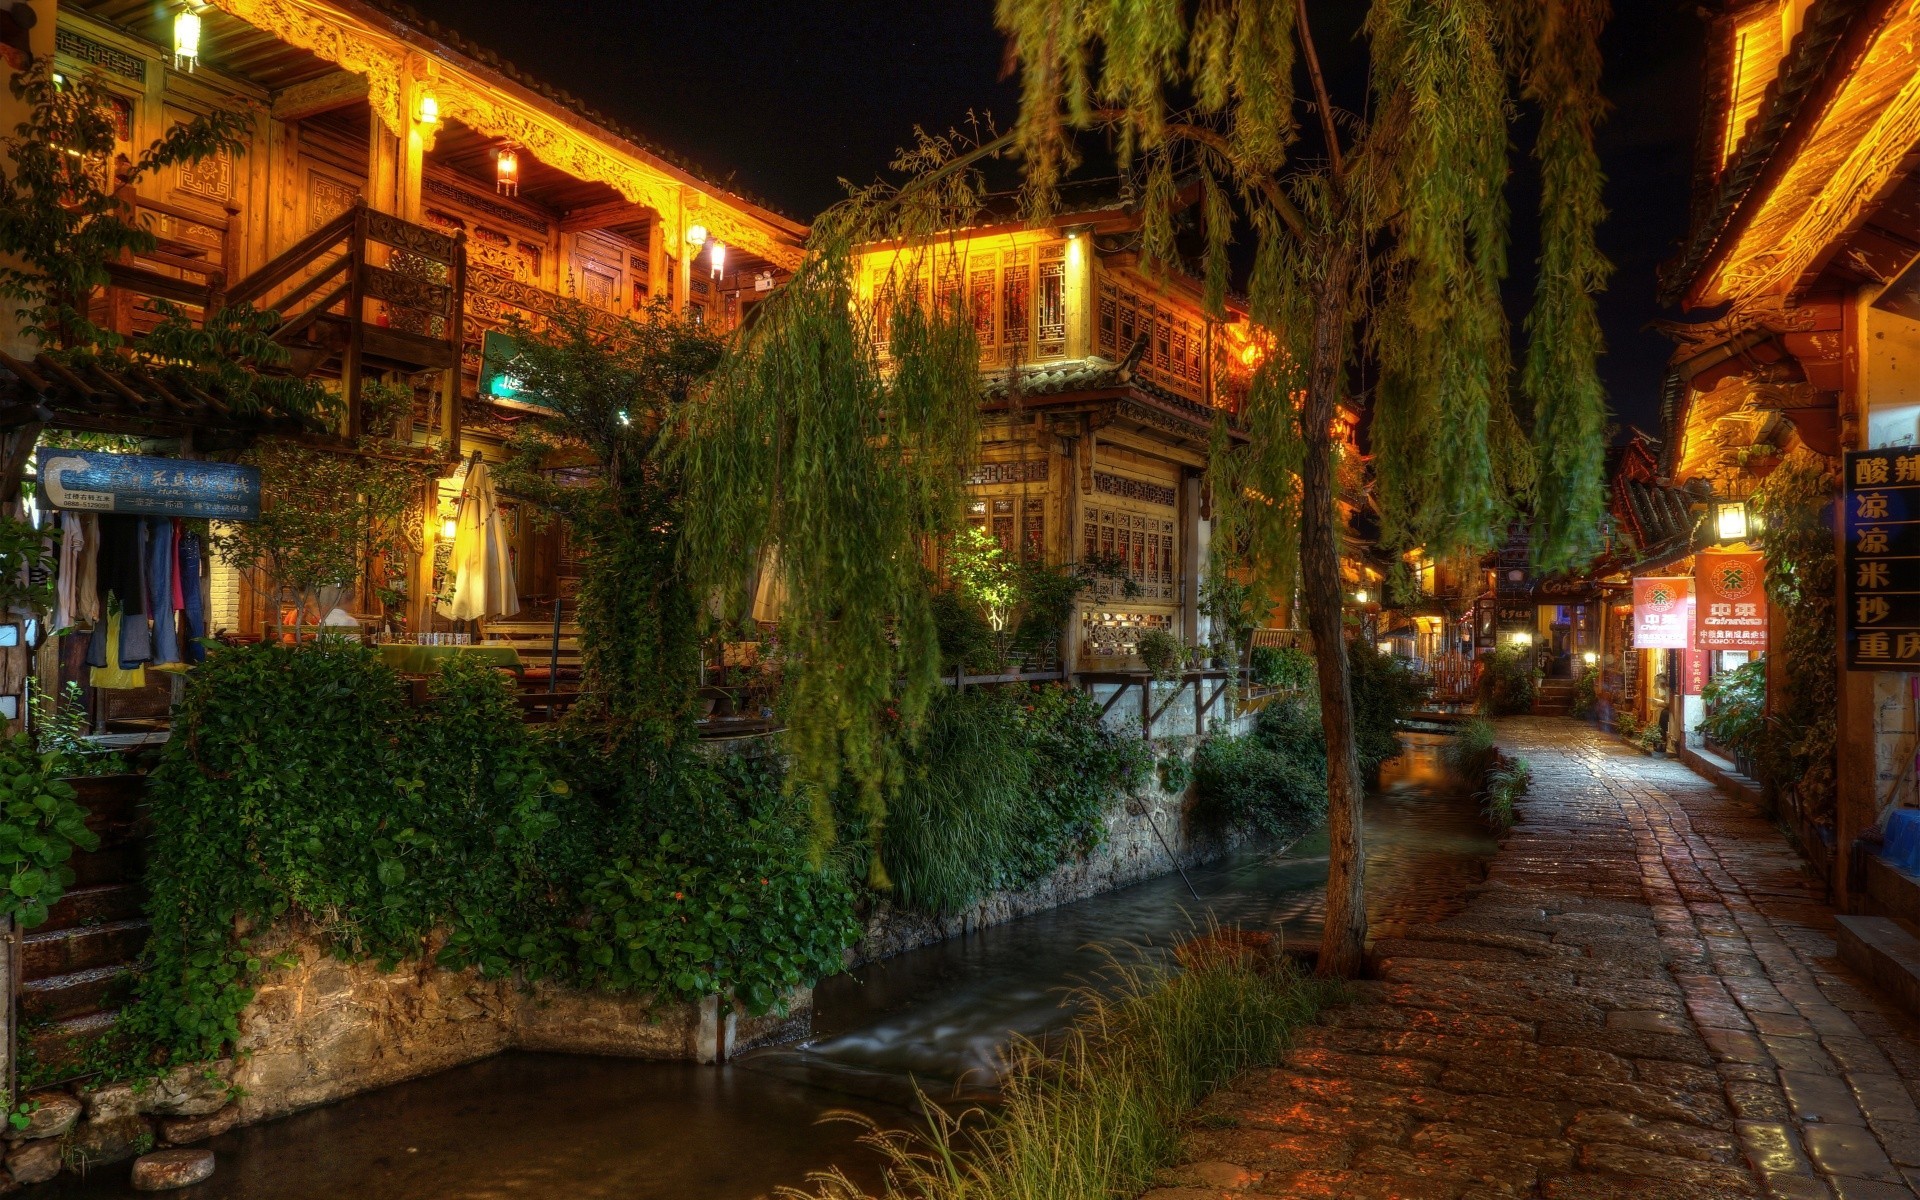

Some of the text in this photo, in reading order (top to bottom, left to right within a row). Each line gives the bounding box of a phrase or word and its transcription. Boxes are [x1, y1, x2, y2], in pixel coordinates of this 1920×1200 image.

[1855, 456, 1920, 485] 酸辣
[1856, 492, 1890, 519] 凉
[1856, 527, 1890, 554] 凉
[1857, 562, 1891, 589] 米
[1710, 602, 1757, 617] 中茶
[1857, 597, 1891, 624] 抄
[1857, 631, 1920, 659] 重庆
